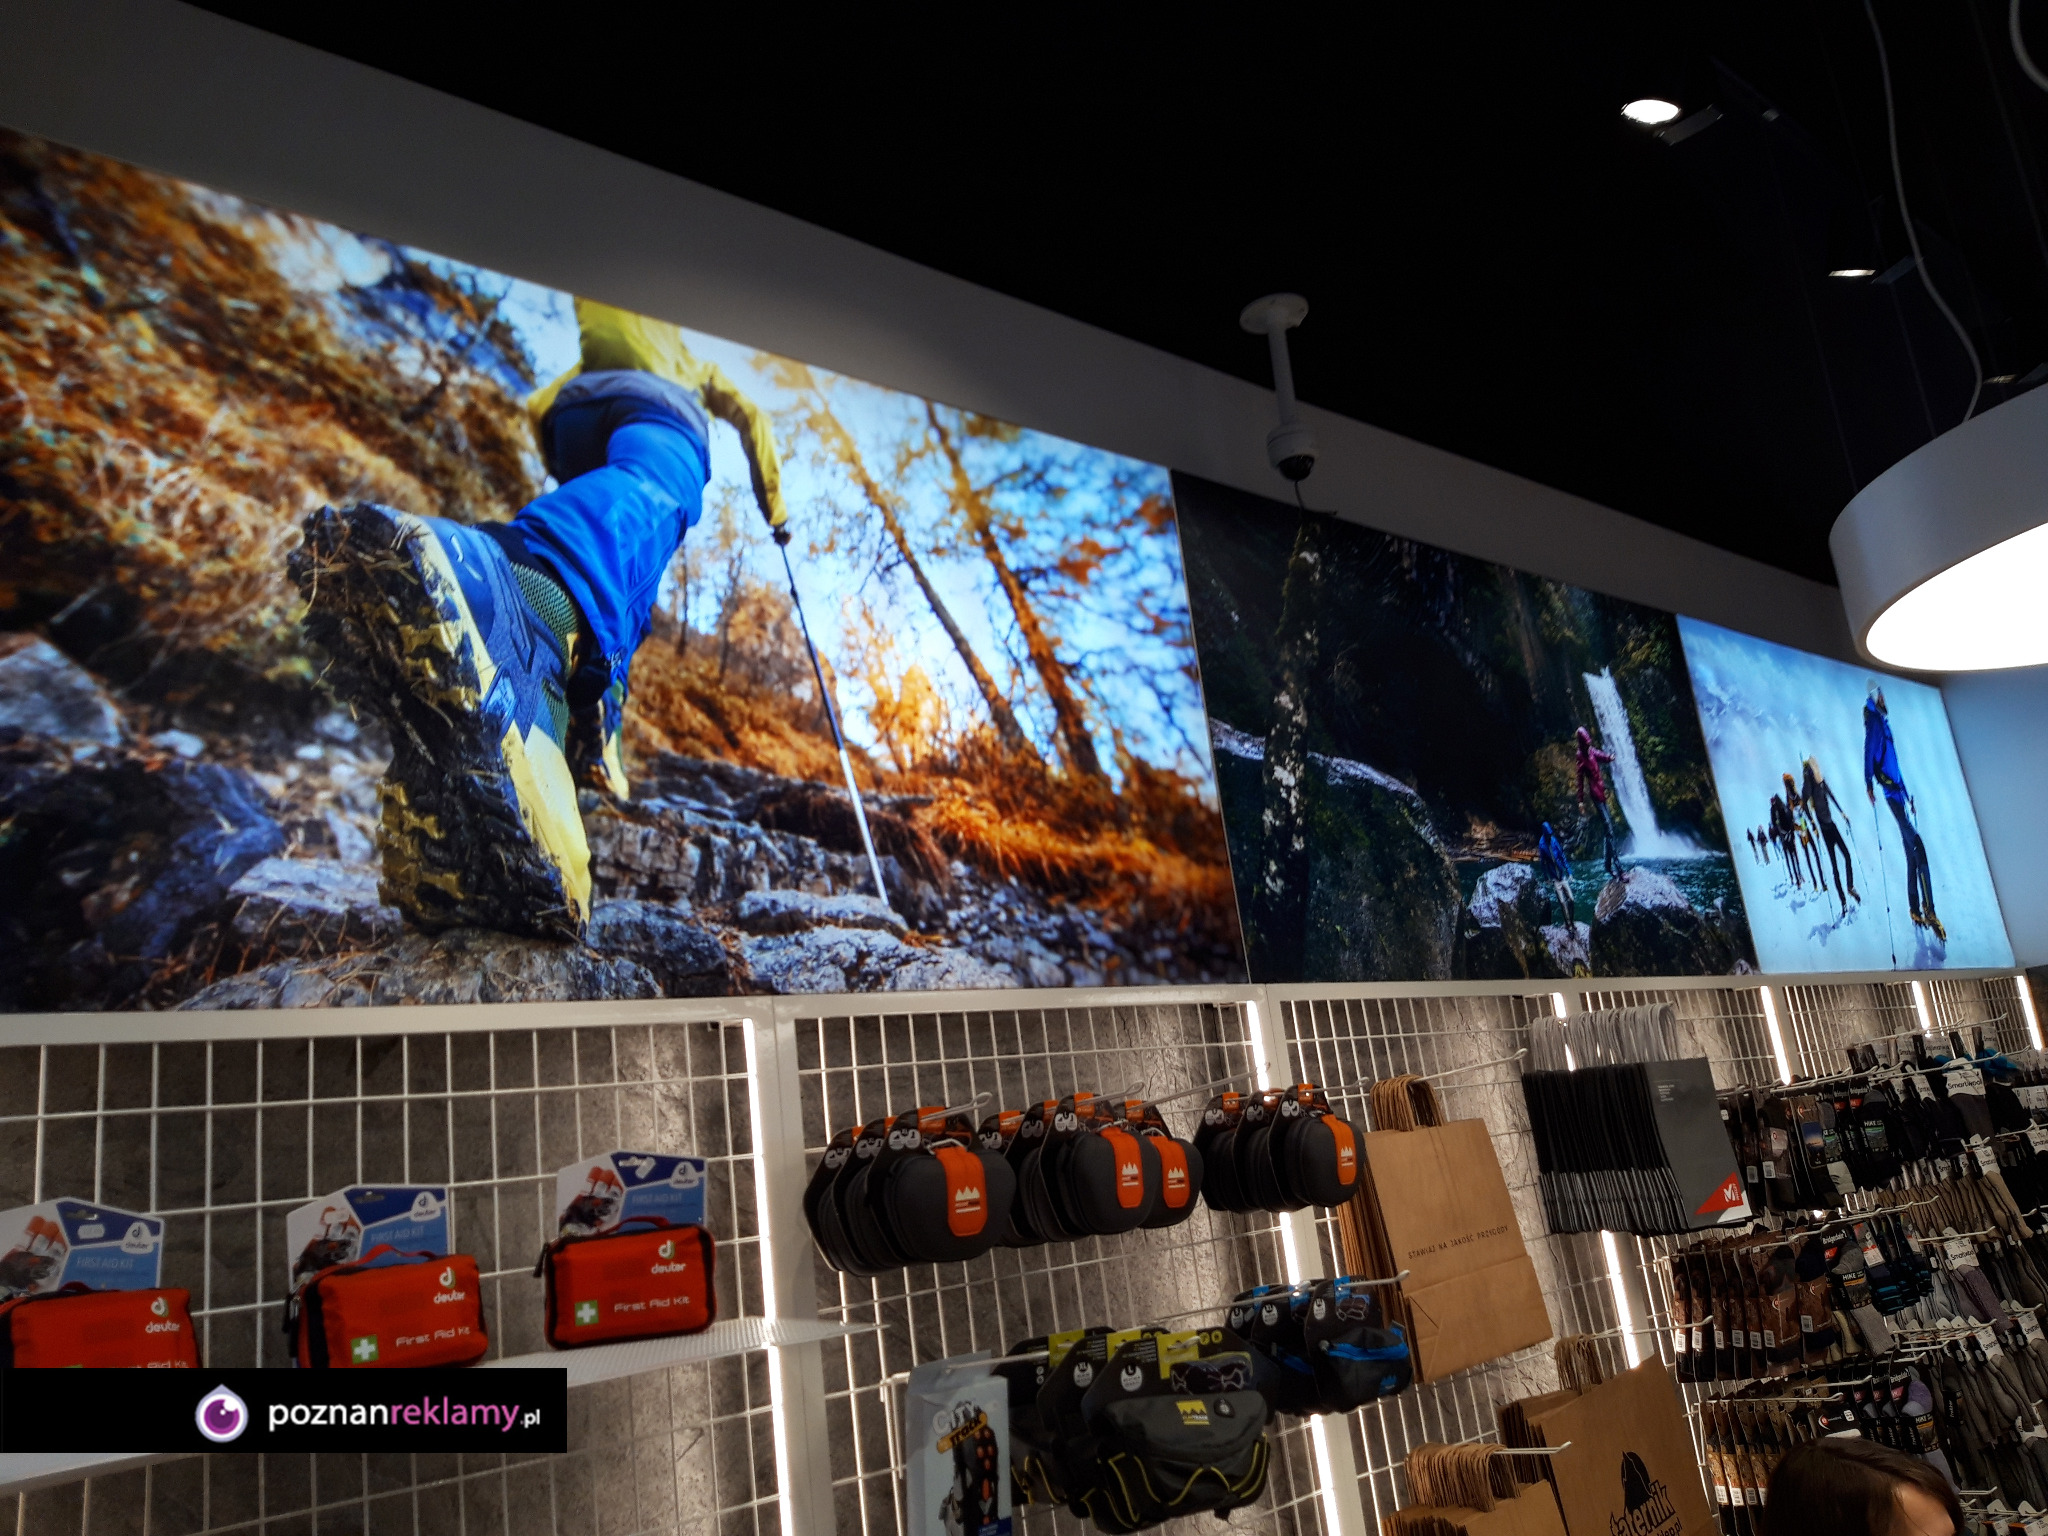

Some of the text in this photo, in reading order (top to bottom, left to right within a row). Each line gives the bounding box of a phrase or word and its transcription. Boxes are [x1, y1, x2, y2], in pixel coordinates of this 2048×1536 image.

[411, 1226, 425, 1239] KIT
[1438, 1242, 1448, 1250] NA
[76, 1256, 135, 1270] FIRST AID KIT
[651, 1261, 686, 1275] deuter
[433, 1289, 466, 1304] deuter
[614, 1296, 690, 1313] First Aid Kit
[145, 1320, 180, 1334] deuter
[395, 1326, 471, 1348] First Aid Kit
